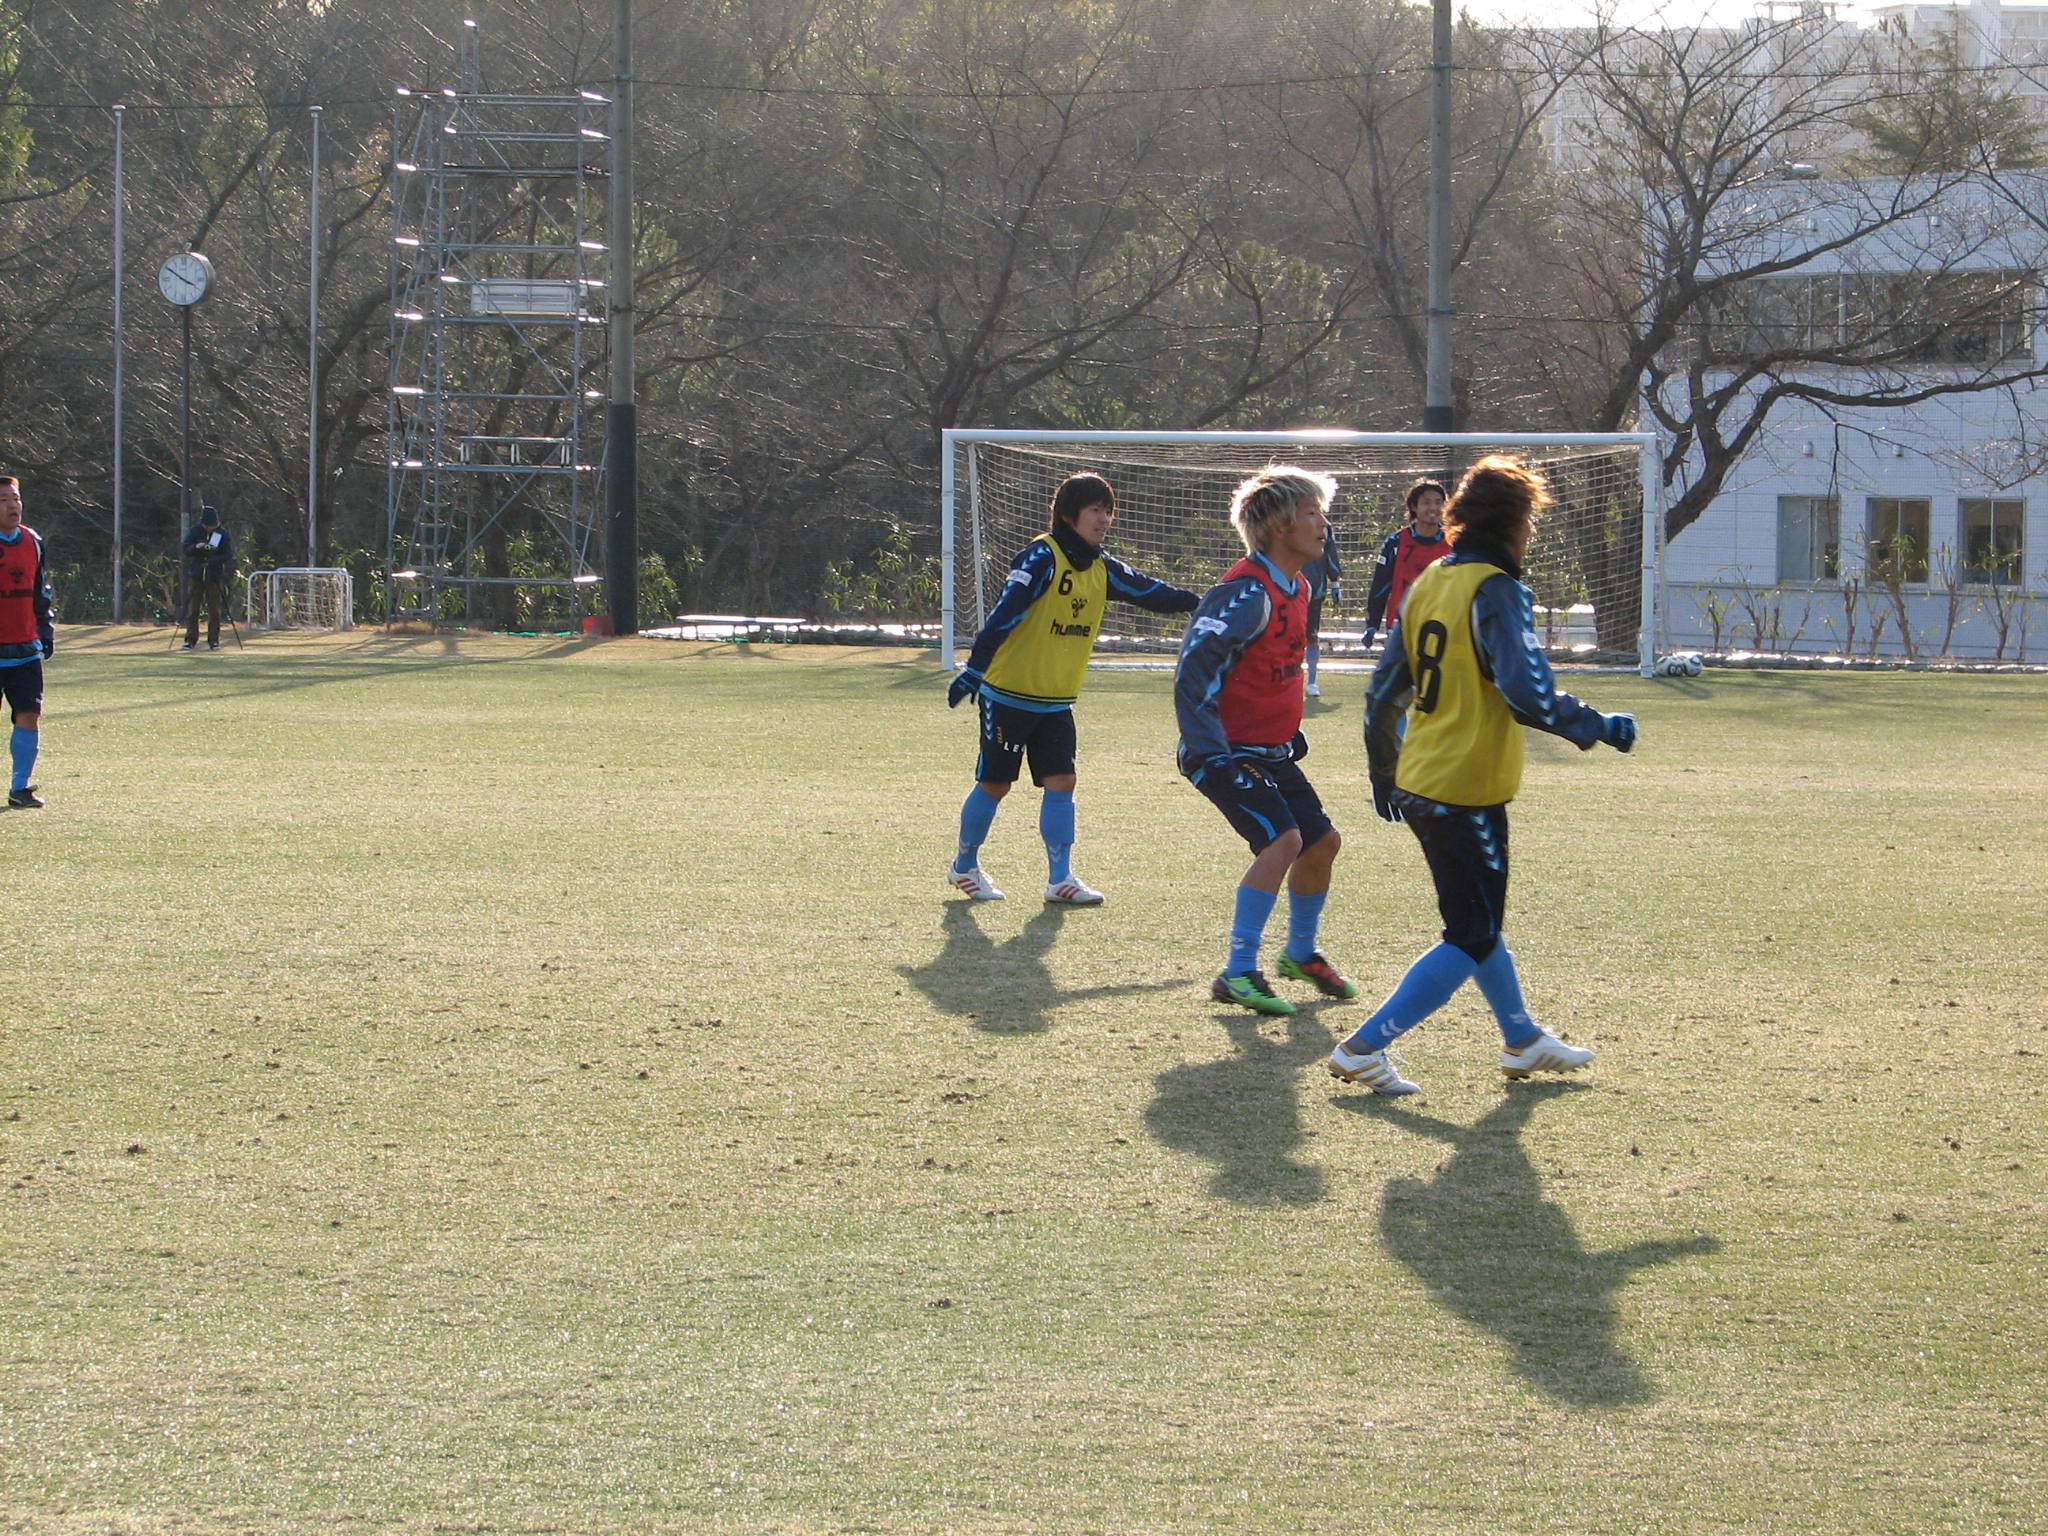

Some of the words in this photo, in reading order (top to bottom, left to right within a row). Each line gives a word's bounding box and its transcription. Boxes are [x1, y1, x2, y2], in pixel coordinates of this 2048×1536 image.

[1404, 544, 1416, 563] 7
[1057, 569, 1074, 596] 6
[1274, 603, 1288, 638] 5
[1415, 619, 1447, 714] 8
